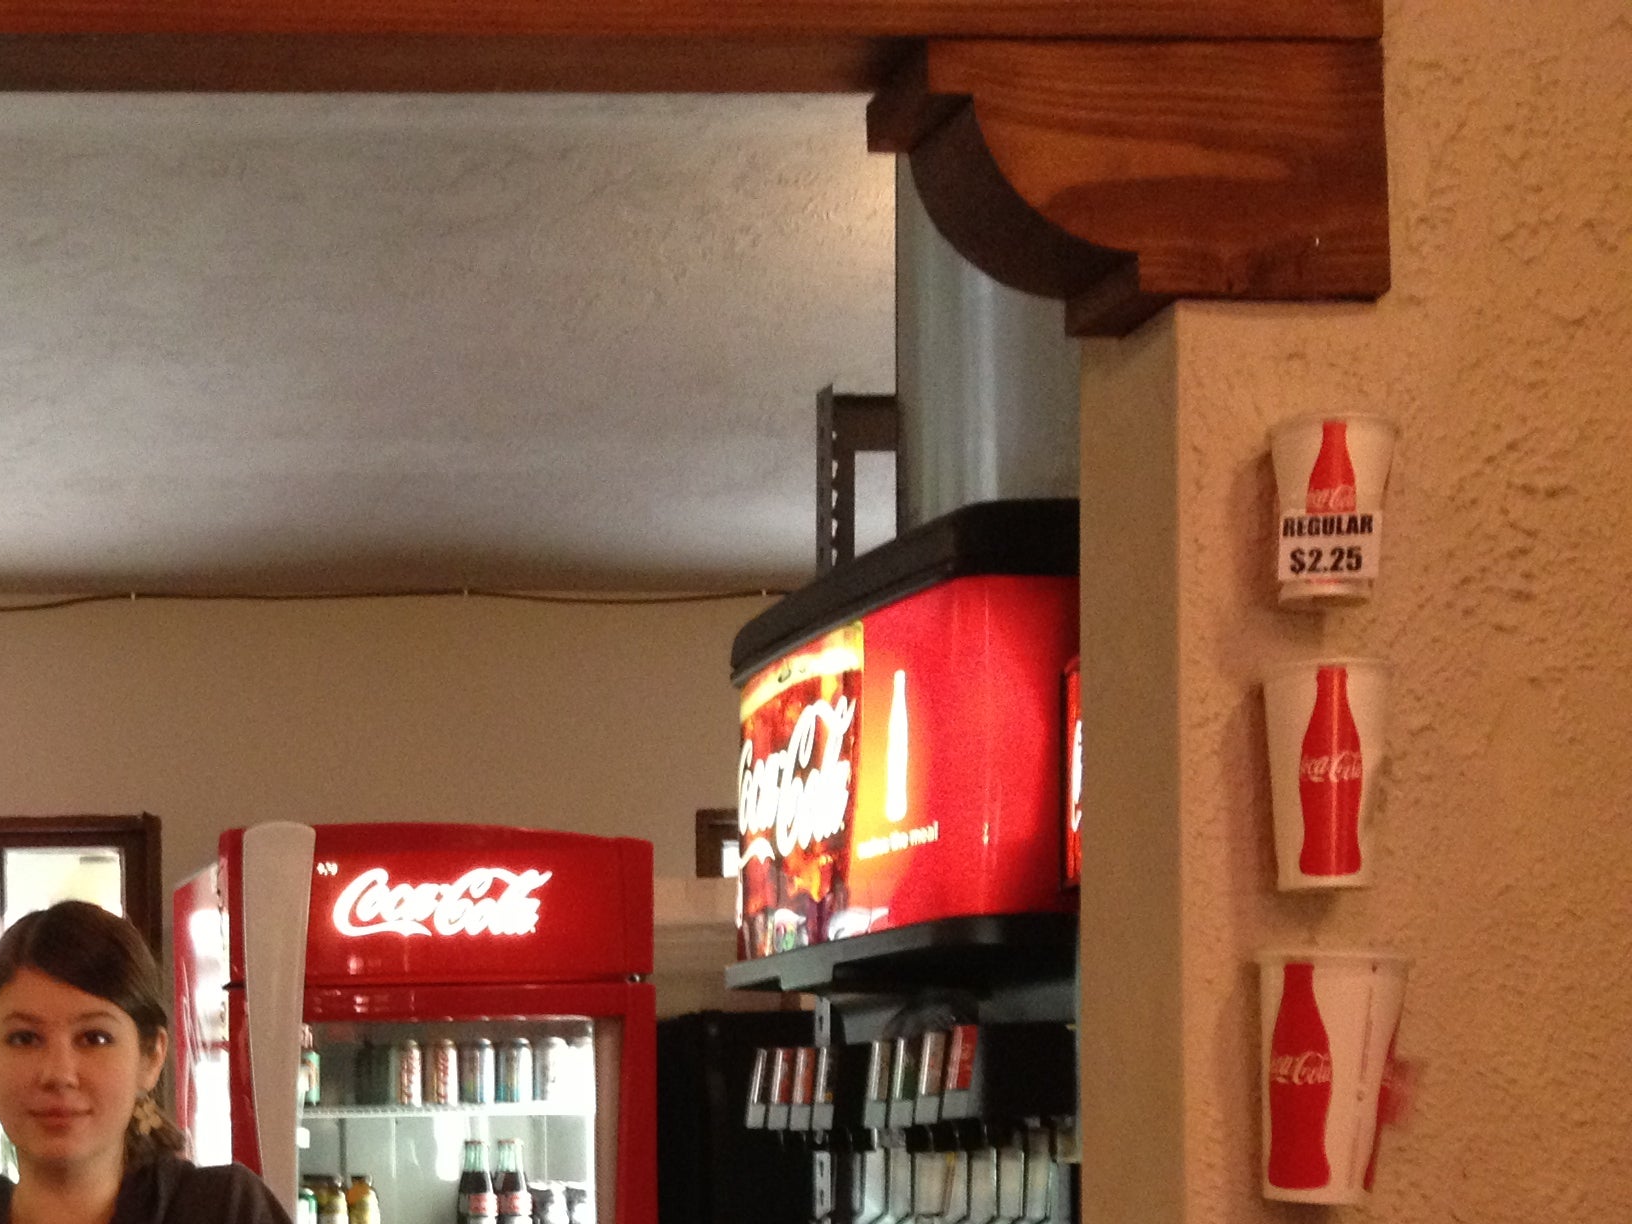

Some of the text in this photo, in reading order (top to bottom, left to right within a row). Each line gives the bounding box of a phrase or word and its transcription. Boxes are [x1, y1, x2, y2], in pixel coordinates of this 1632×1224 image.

[1282, 514, 1374, 538] REGULAR
[1289, 546, 1363, 575] $2.25
[332, 867, 554, 937] Coca-Cola
